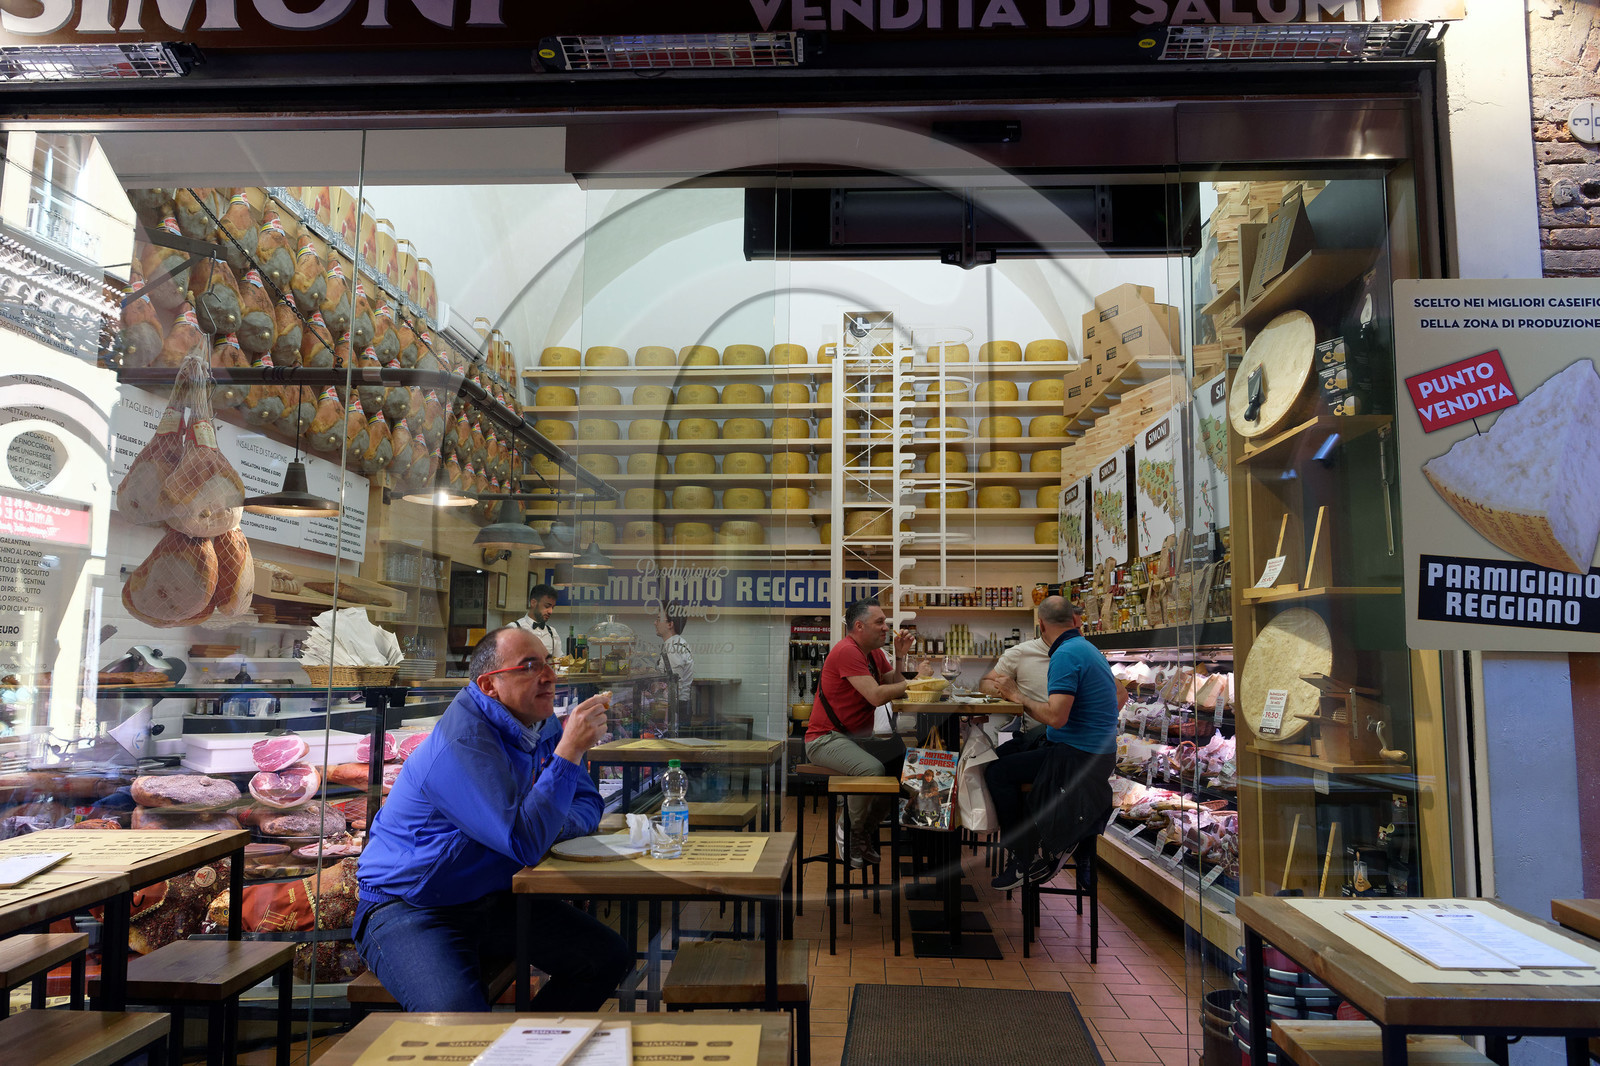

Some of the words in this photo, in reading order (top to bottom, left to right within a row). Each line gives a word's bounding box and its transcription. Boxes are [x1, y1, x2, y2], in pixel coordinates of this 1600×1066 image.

[748, 0, 1023, 31] VENDITA
[1046, 0, 1109, 28] DI
[1414, 298, 1460, 308] SCELTO
[1463, 298, 1485, 308] NEI
[1488, 298, 1545, 308] MIGLIORI
[1421, 318, 1459, 329] DELLA
[1463, 318, 1498, 329] ZONA
[1502, 318, 1514, 329] DI
[1518, 318, 1600, 329] PRODUZIONE
[1418, 362, 1494, 399] PUNTO
[125, 398, 154, 417] TAGLIERI
[1419, 383, 1513, 422] VENDITA
[1148, 422, 1167, 446] SIMONI
[236, 439, 259, 454] INSALATE
[265, 449, 288, 464] STAGIONE
[0, 537, 31, 546] GALANTINA
[3, 556, 21, 564] DELLA
[637, 557, 729, 584] Produzione
[1428, 562, 1600, 599] PARMIGIANO
[644, 597, 720, 623] Vendita
[1446, 592, 1581, 626] REGGIANO
[919, 758, 955, 769] SORPRESE
[925, 751, 953, 760] MITICHE
